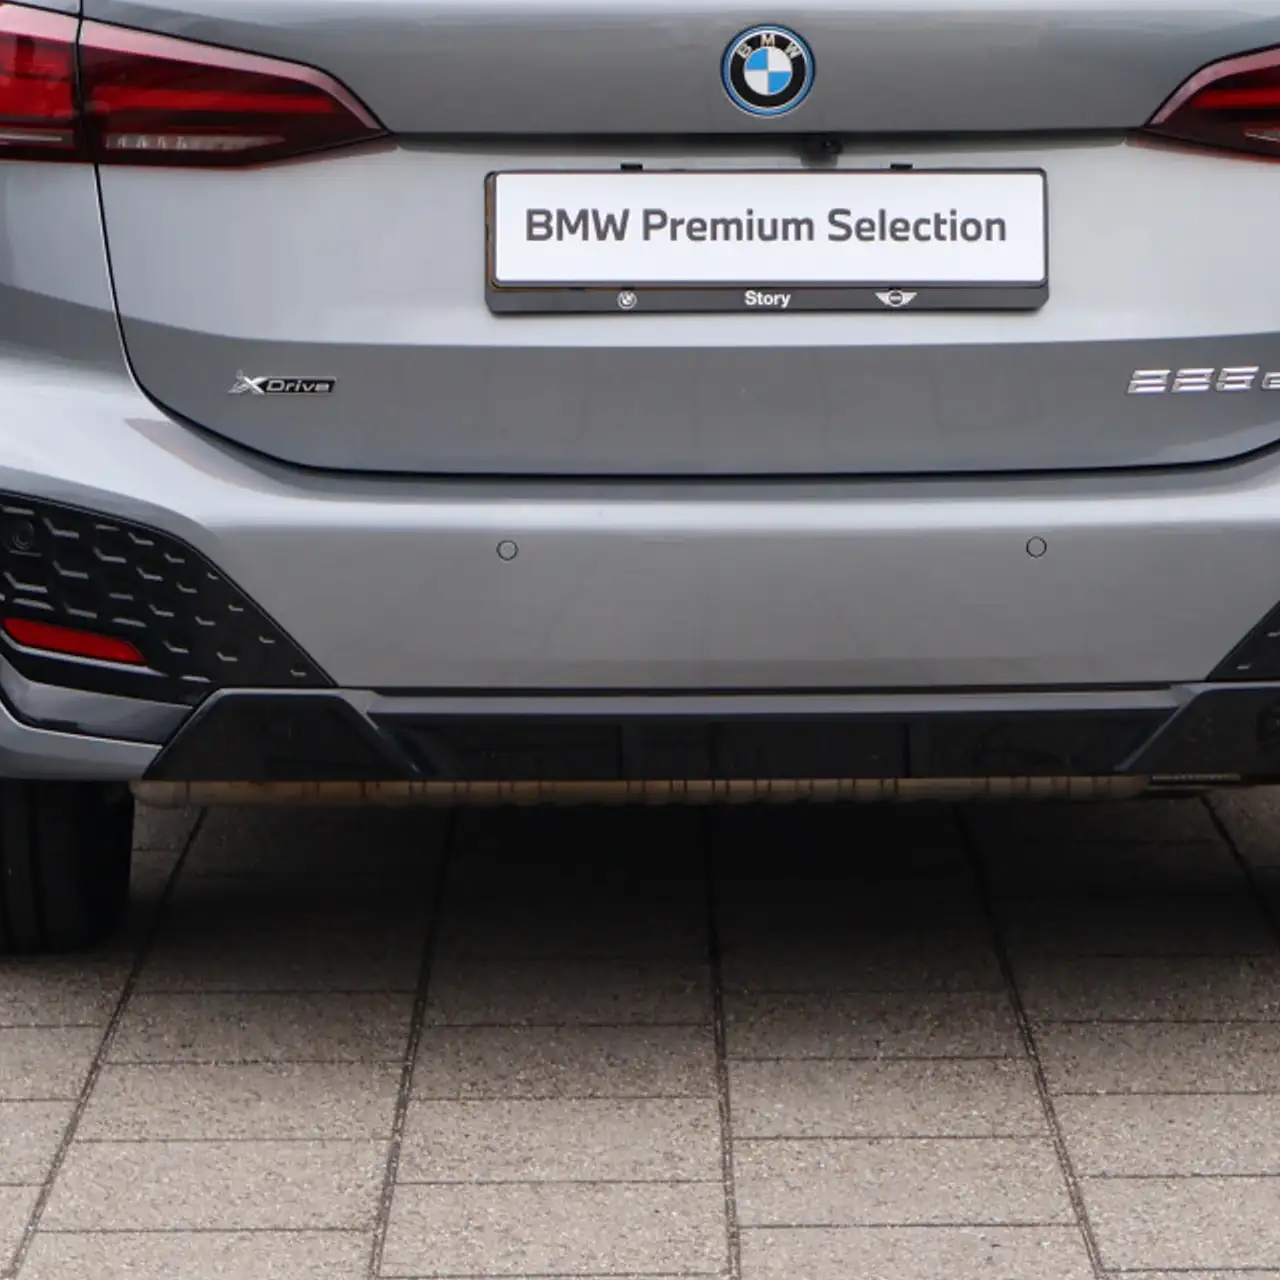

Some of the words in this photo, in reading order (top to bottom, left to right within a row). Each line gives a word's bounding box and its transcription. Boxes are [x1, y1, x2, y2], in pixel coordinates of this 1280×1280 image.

[736, 33, 802, 59] BMW
[525, 208, 630, 242] BMW
[643, 209, 815, 242] Premium
[827, 208, 1007, 243] Selection
[744, 290, 791, 308] Story
